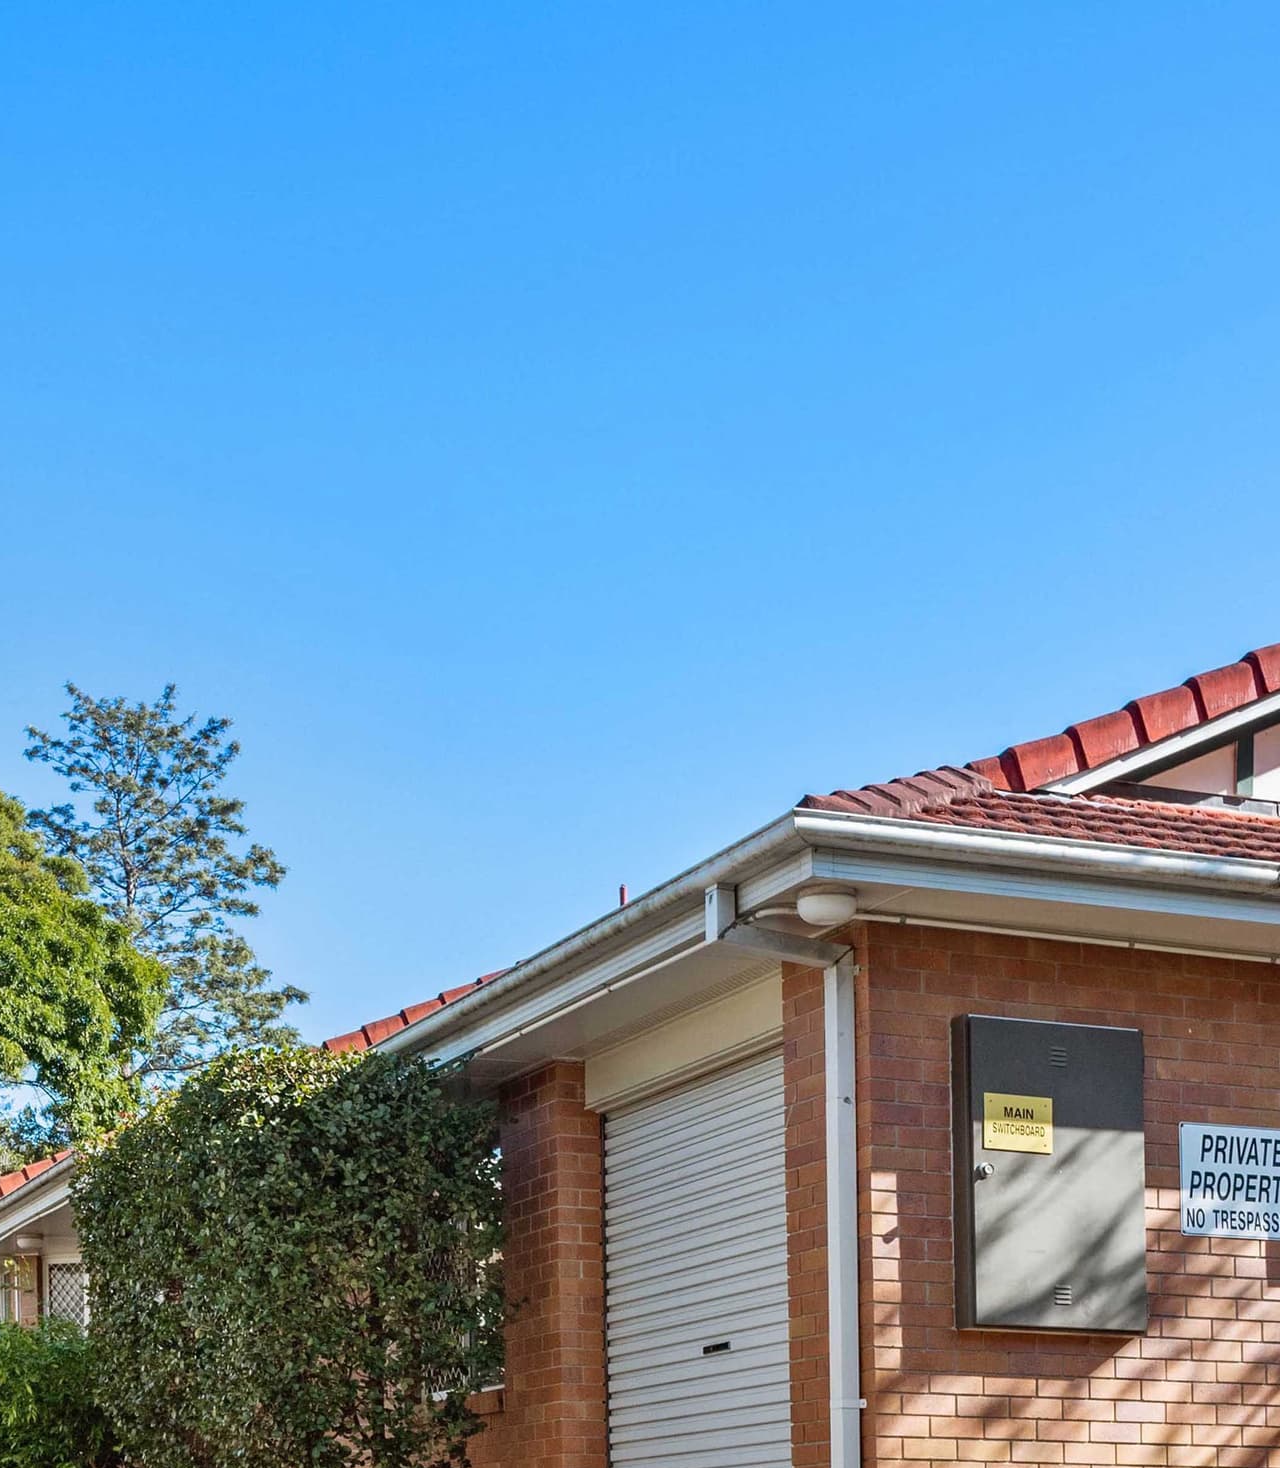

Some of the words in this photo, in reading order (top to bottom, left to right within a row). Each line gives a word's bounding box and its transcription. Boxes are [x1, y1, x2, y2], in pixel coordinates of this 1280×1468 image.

[1003, 1106, 1034, 1120] MAIN
[992, 1122, 1046, 1138] SWITCHBOARD
[1186, 1207, 1206, 1229] NO
